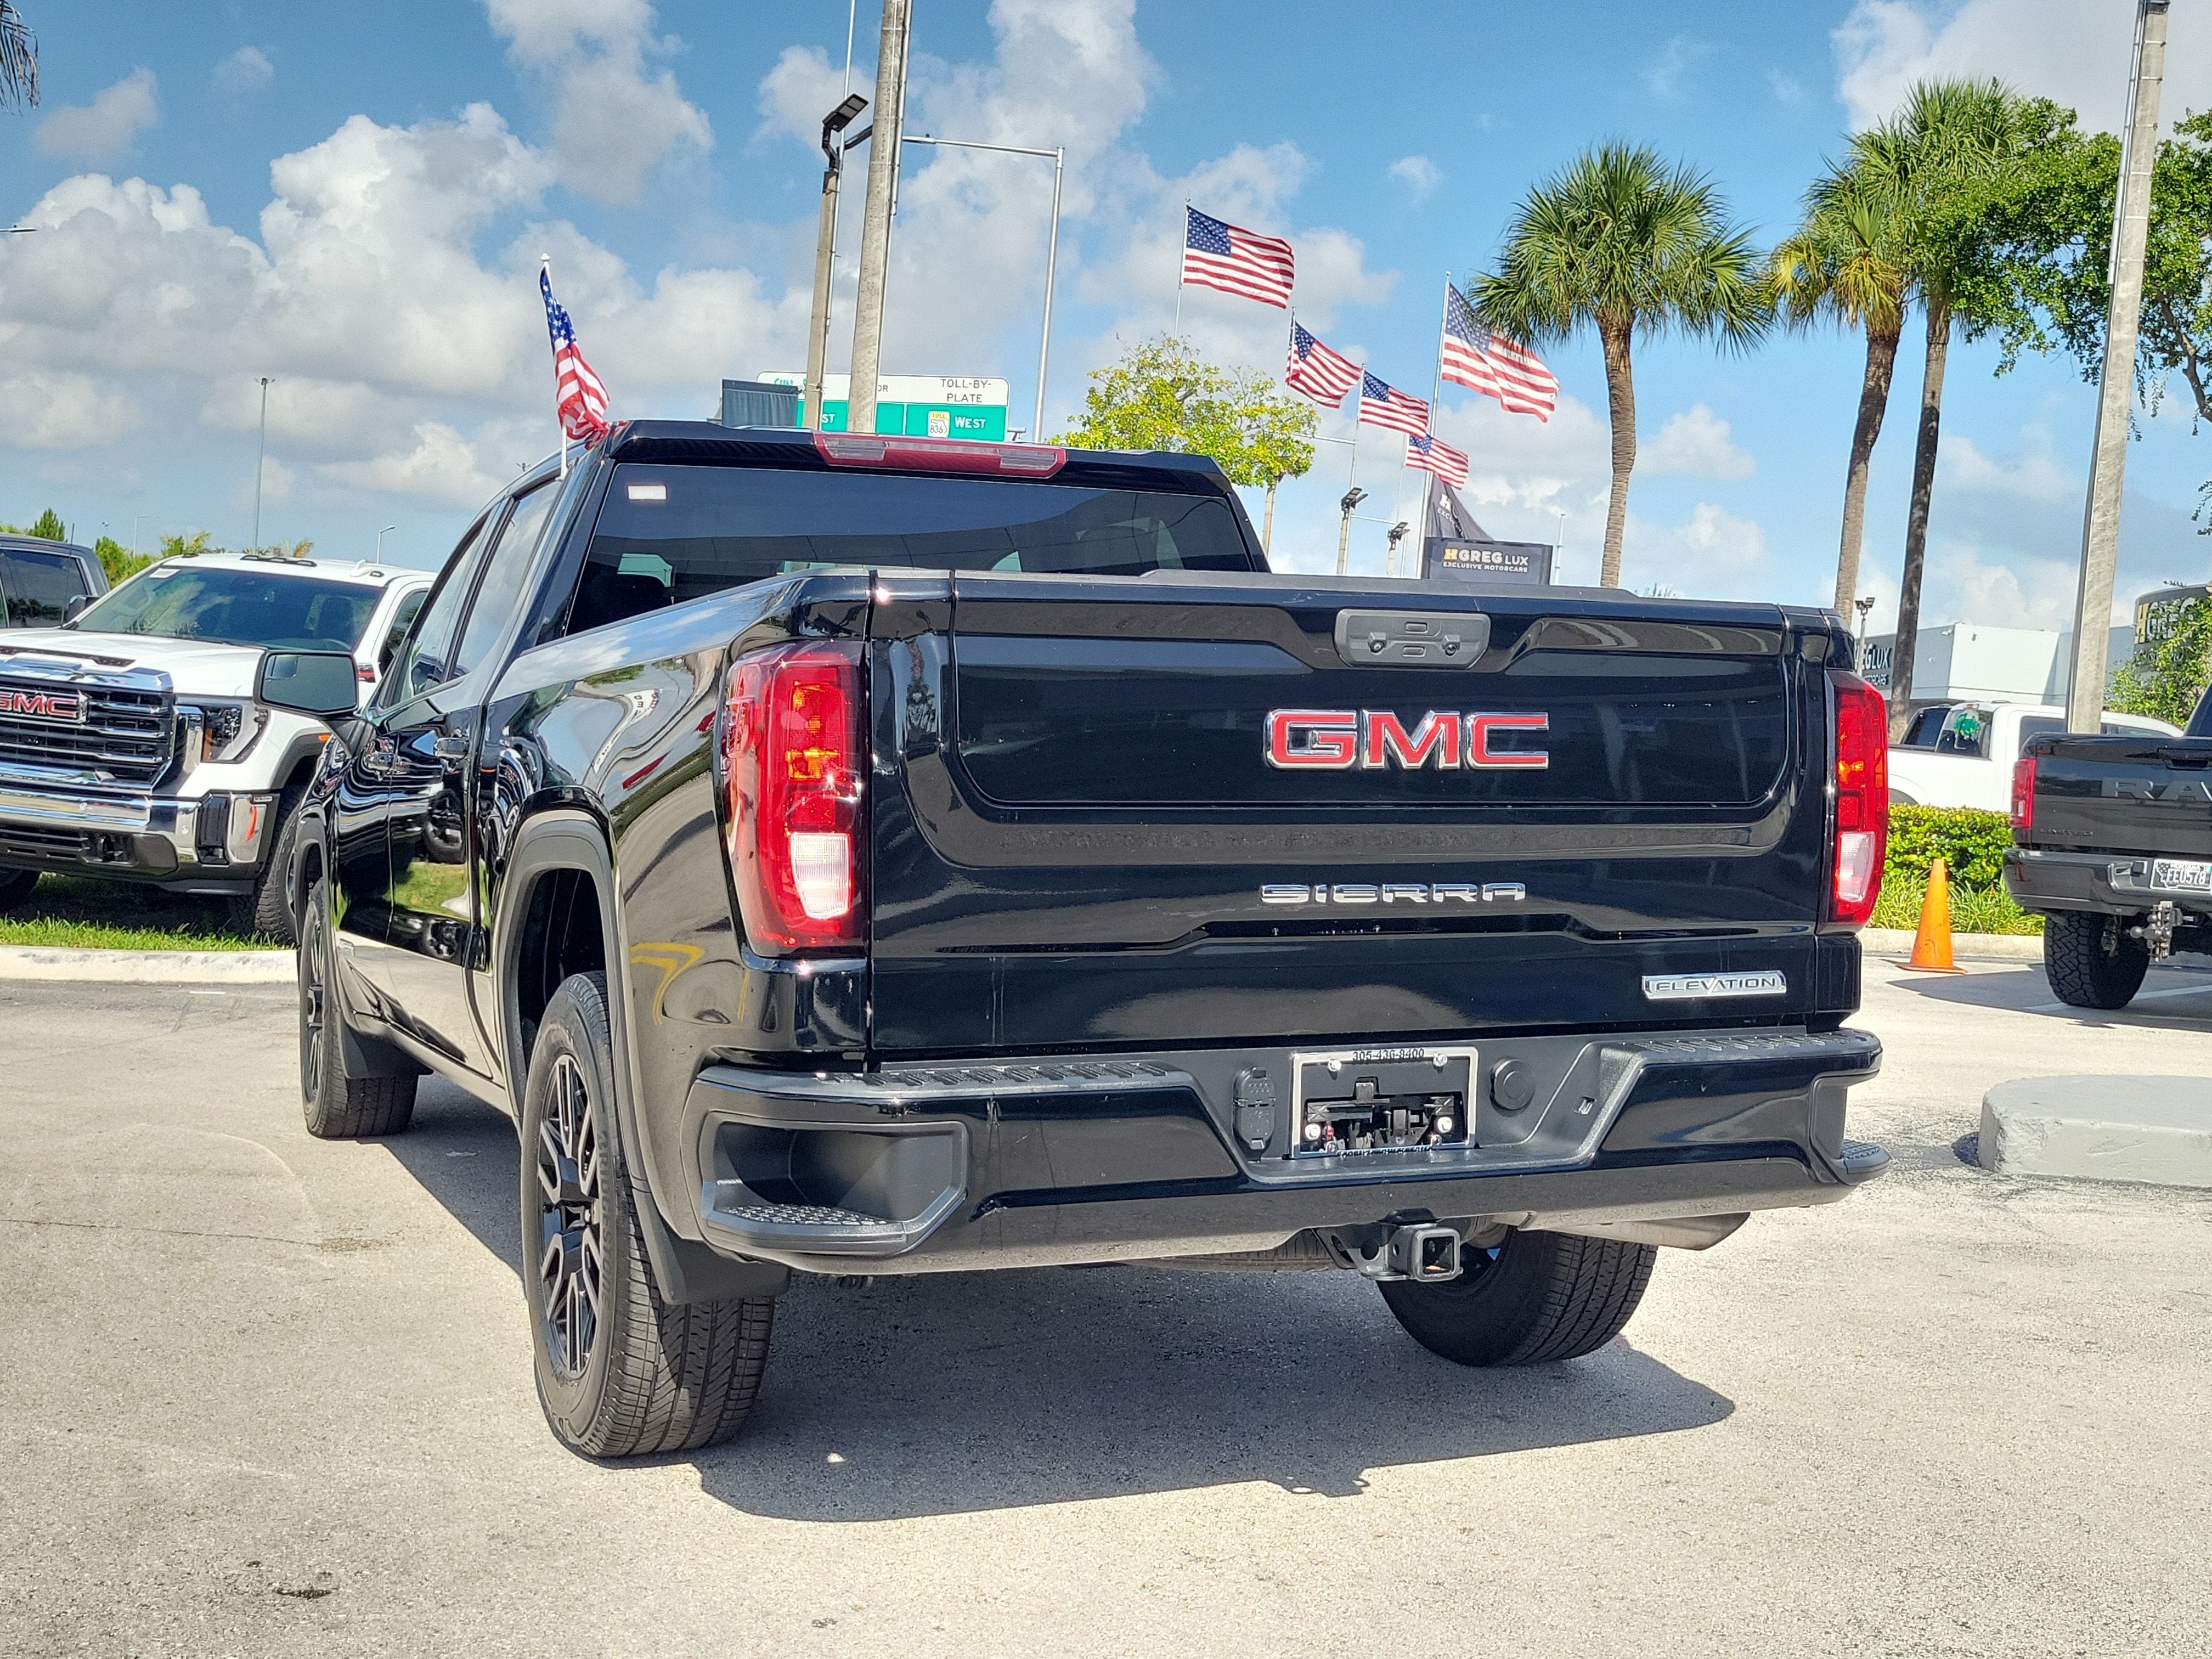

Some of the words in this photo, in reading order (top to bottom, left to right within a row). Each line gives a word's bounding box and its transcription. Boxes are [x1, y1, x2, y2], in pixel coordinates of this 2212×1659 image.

[941, 379, 992, 388] TOLL-BY-
[946, 393, 983, 403] PLATE
[955, 416, 986, 429] WEST
[930, 425, 944, 434] 836
[1443, 561, 1482, 570] EXCLUSIVE
[1483, 565, 1528, 573] MOTORCARS
[1504, 555, 1529, 566] LUX
[1265, 708, 1549, 769] GMC
[2166, 867, 2207, 885] FEU578
[1260, 882, 1527, 904] SIERRA
[1656, 977, 1777, 995] ELEVATION
[1352, 1048, 1425, 1061] 305-436-8400
